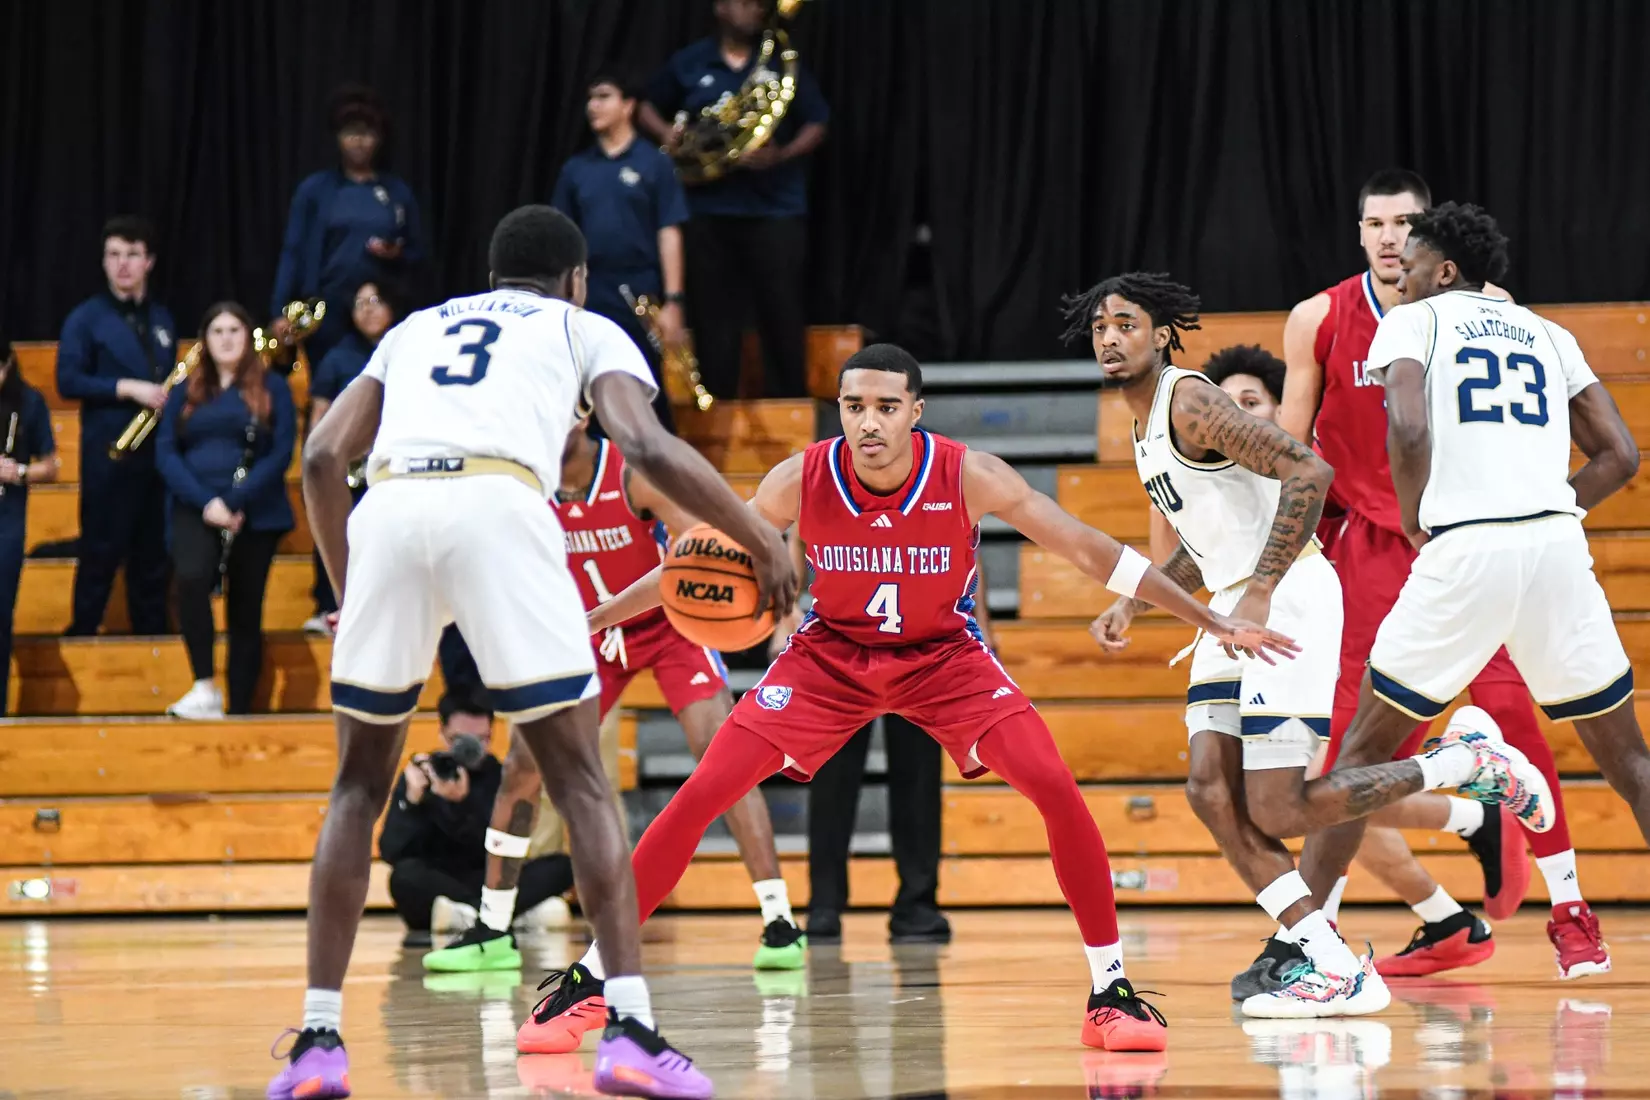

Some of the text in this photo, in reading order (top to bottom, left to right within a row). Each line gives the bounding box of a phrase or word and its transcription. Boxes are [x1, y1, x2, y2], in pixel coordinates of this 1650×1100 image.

[1455, 319, 1536, 349] SALATCHOUM
[430, 318, 502, 386] 3
[1455, 346, 1549, 427] 23
[596, 525, 634, 552] TECH
[675, 538, 753, 569] Wilson
[813, 544, 951, 574] LOUISIANA TECH
[582, 558, 615, 604] 1
[676, 579, 733, 603] NCAA
[864, 582, 903, 634] 4
